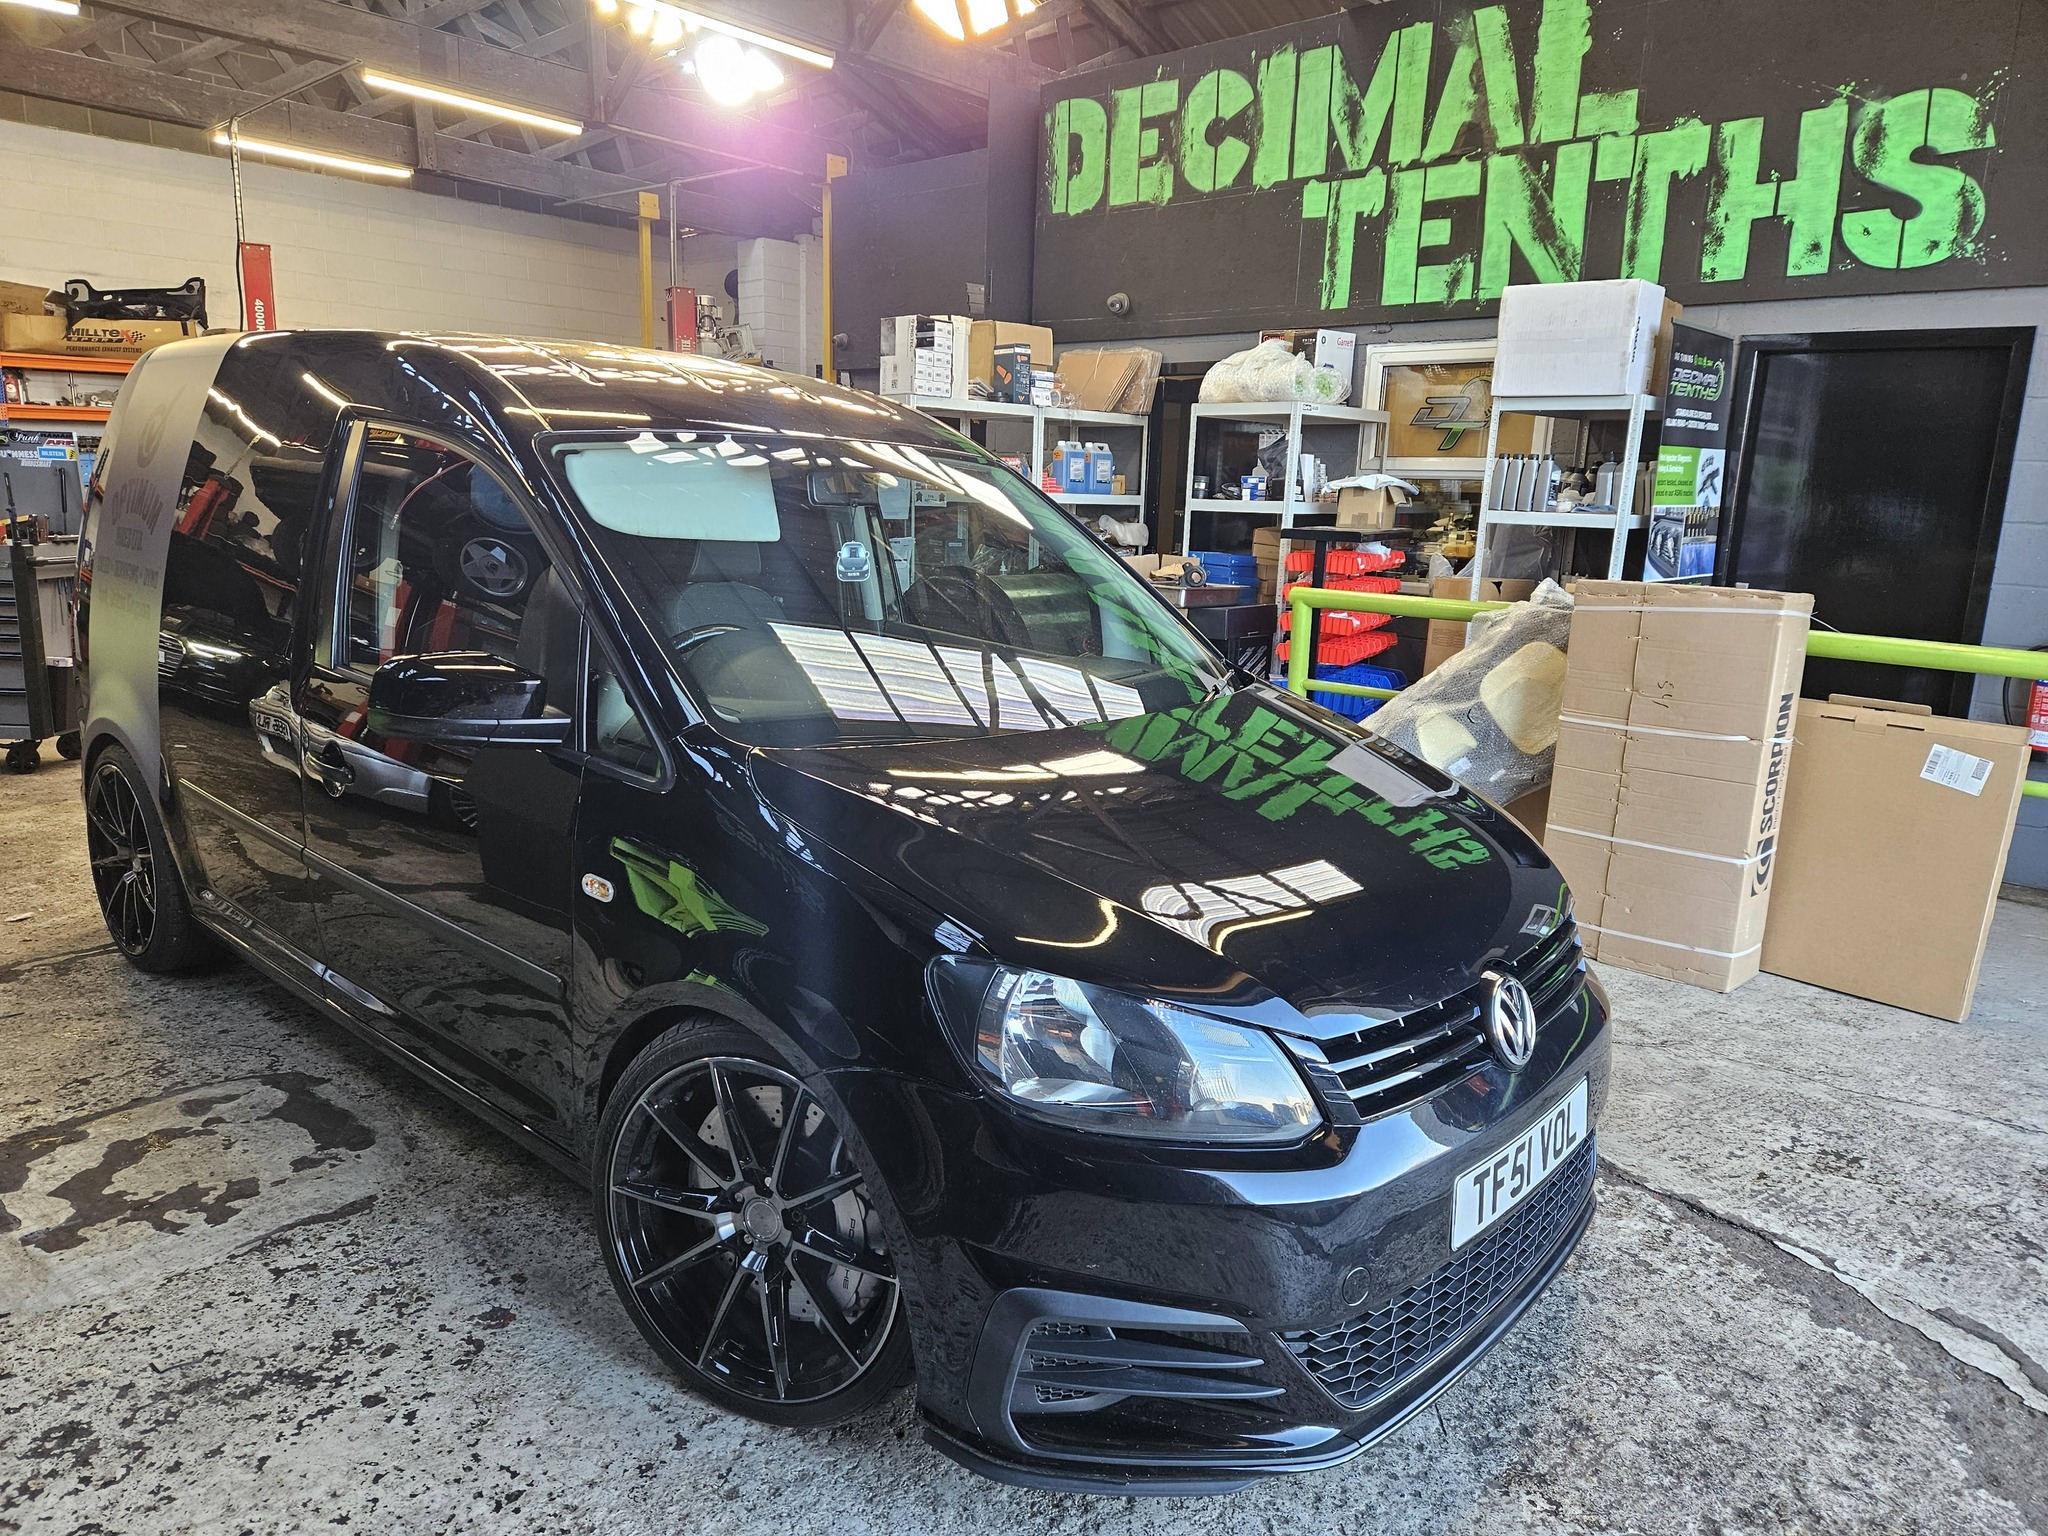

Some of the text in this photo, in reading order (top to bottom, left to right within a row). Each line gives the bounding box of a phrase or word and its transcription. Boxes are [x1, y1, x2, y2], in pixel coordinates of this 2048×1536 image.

[1047, 0, 1639, 216] DECIMAL
[1301, 86, 1996, 310] TENTHS
[1669, 381, 1717, 401] TENTHS
[1760, 692, 1794, 835] SCORPION
[1473, 1101, 1577, 1226] TF51 VOL
